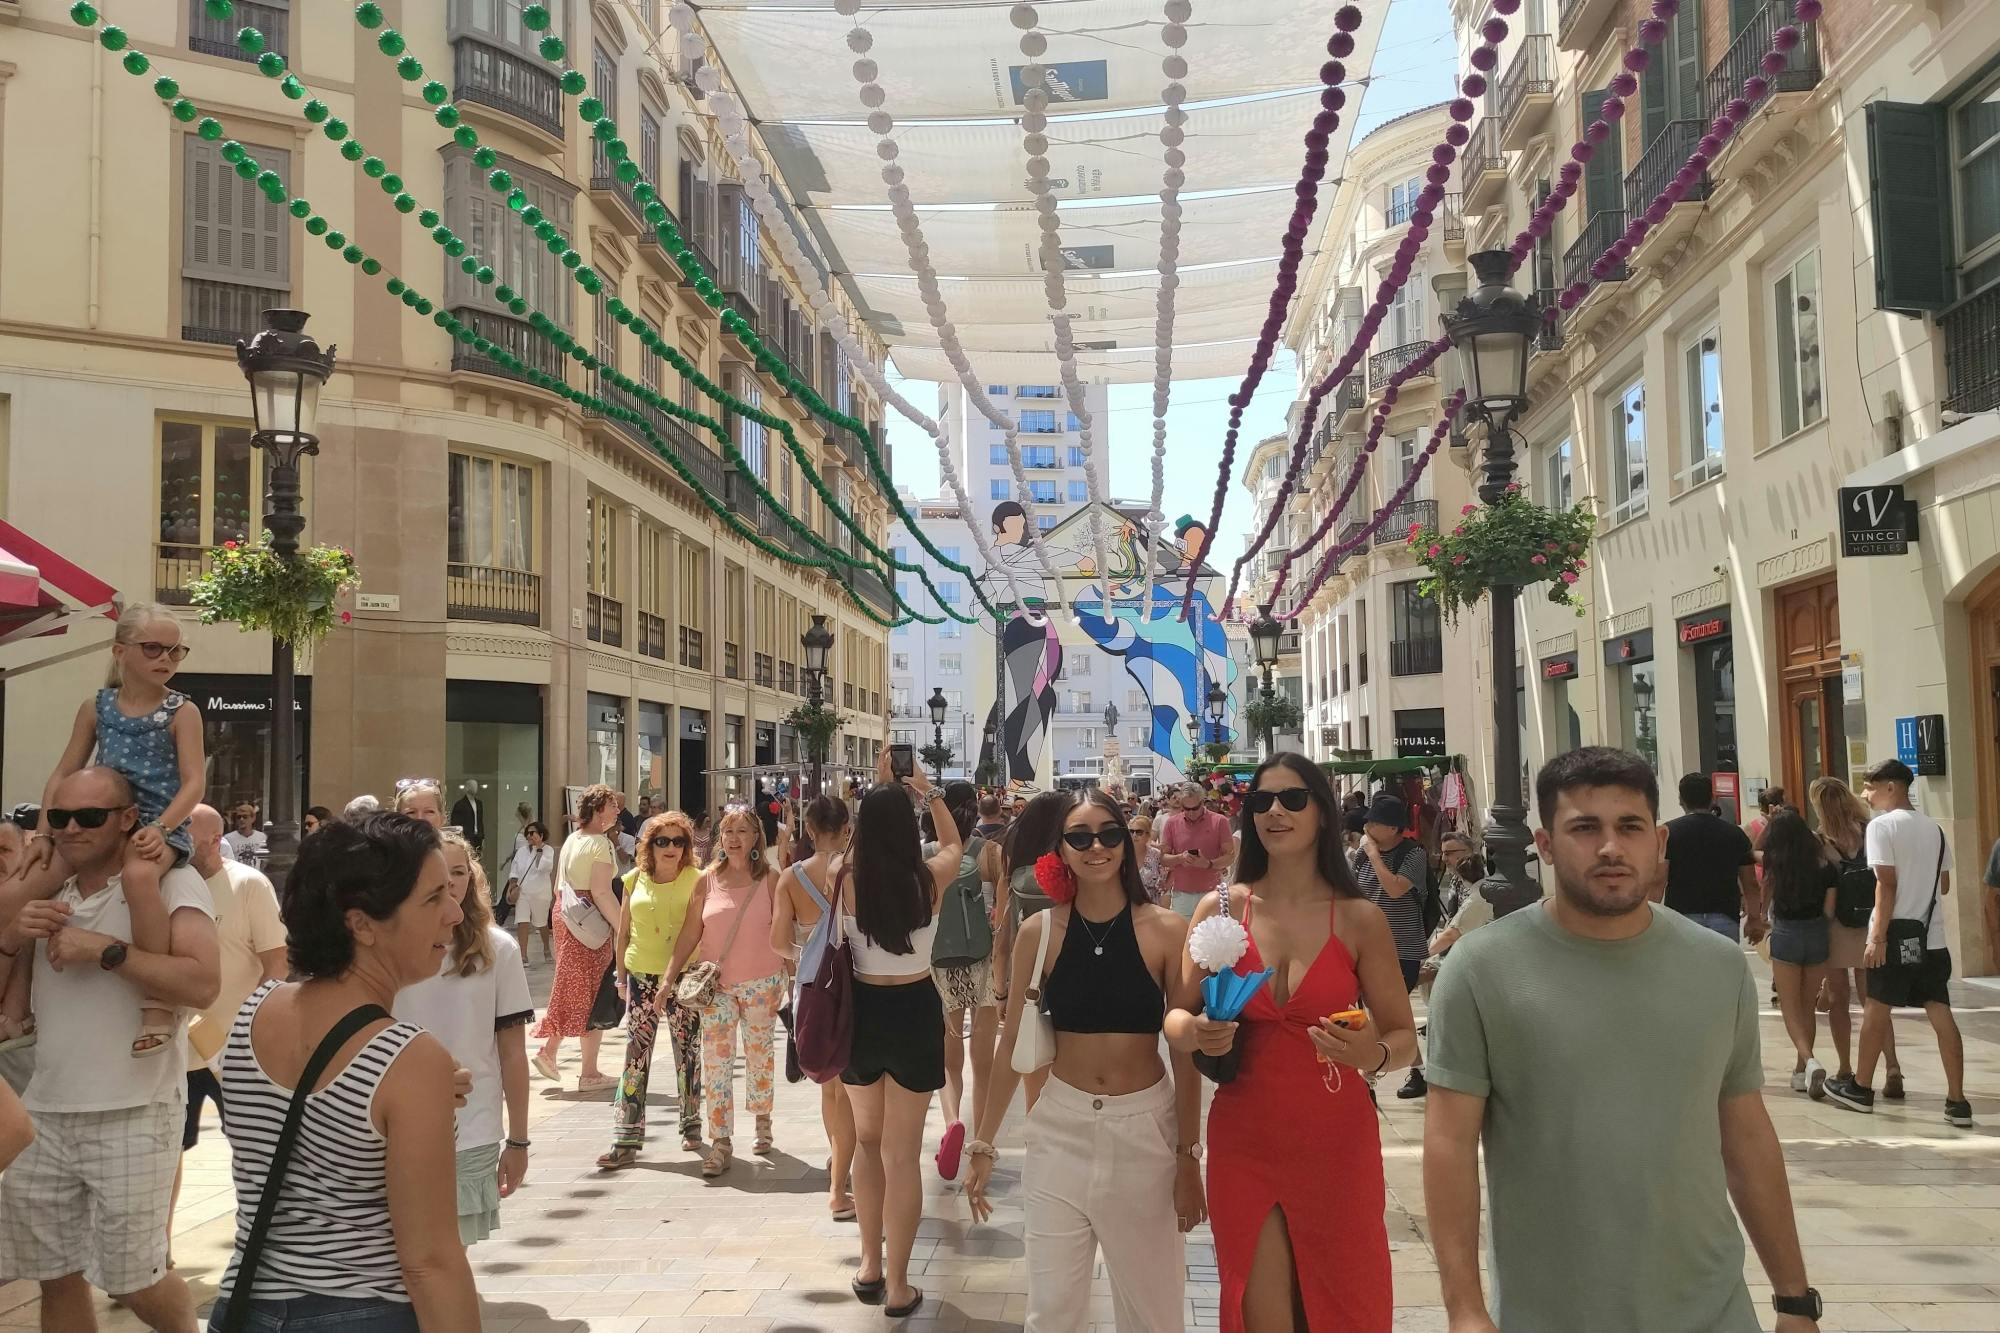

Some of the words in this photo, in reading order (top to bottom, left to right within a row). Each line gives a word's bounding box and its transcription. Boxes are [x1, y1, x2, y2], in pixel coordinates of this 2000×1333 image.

[1852, 489, 1894, 527] V
[1851, 532, 1900, 542] VINCCI
[1853, 543, 1902, 553] HOTELES
[208, 697, 265, 711] Massimo
[1901, 722, 1914, 749] H
[1918, 718, 1933, 751] V
